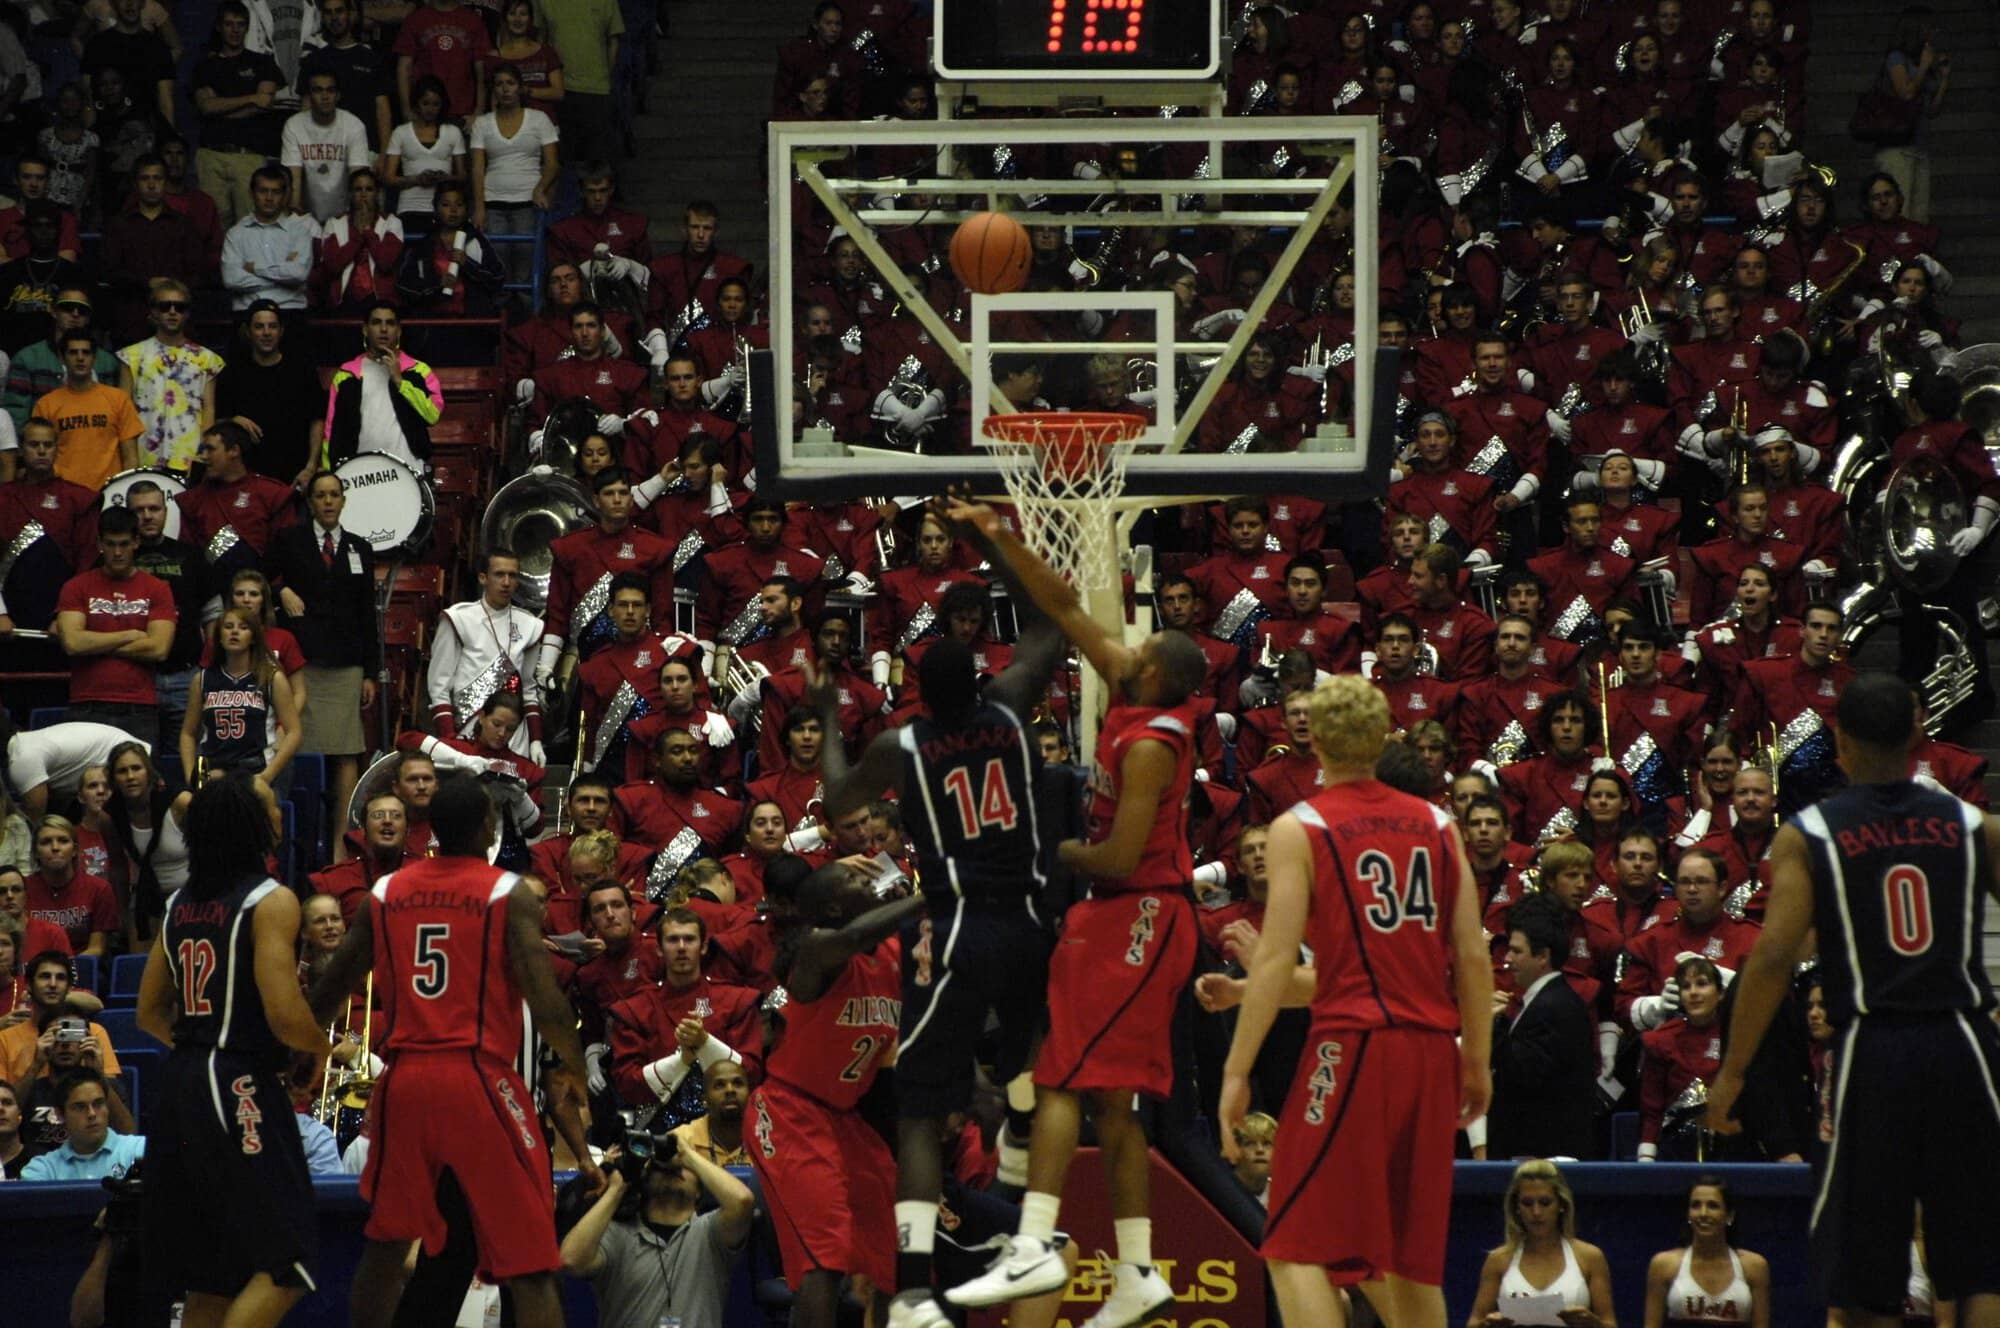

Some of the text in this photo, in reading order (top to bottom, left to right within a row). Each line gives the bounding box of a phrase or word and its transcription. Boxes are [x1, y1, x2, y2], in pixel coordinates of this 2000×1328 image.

[57, 413, 109, 432] KAPPA SIG
[351, 468, 400, 489] YAMAHA
[214, 708, 248, 741] 55
[943, 754, 1018, 840] 14
[1836, 815, 1962, 858] BAYLESS
[173, 899, 232, 928] DILLON
[1357, 846, 1438, 931] 34
[1882, 863, 1933, 957] 0
[412, 923, 450, 1000] 5
[1125, 896, 1163, 967] CATS
[178, 938, 216, 1016] 12
[232, 1073, 264, 1155] CATS
[497, 1078, 537, 1149] CATS
[1304, 1041, 1343, 1125] CATS
[755, 1093, 776, 1159] CATS
